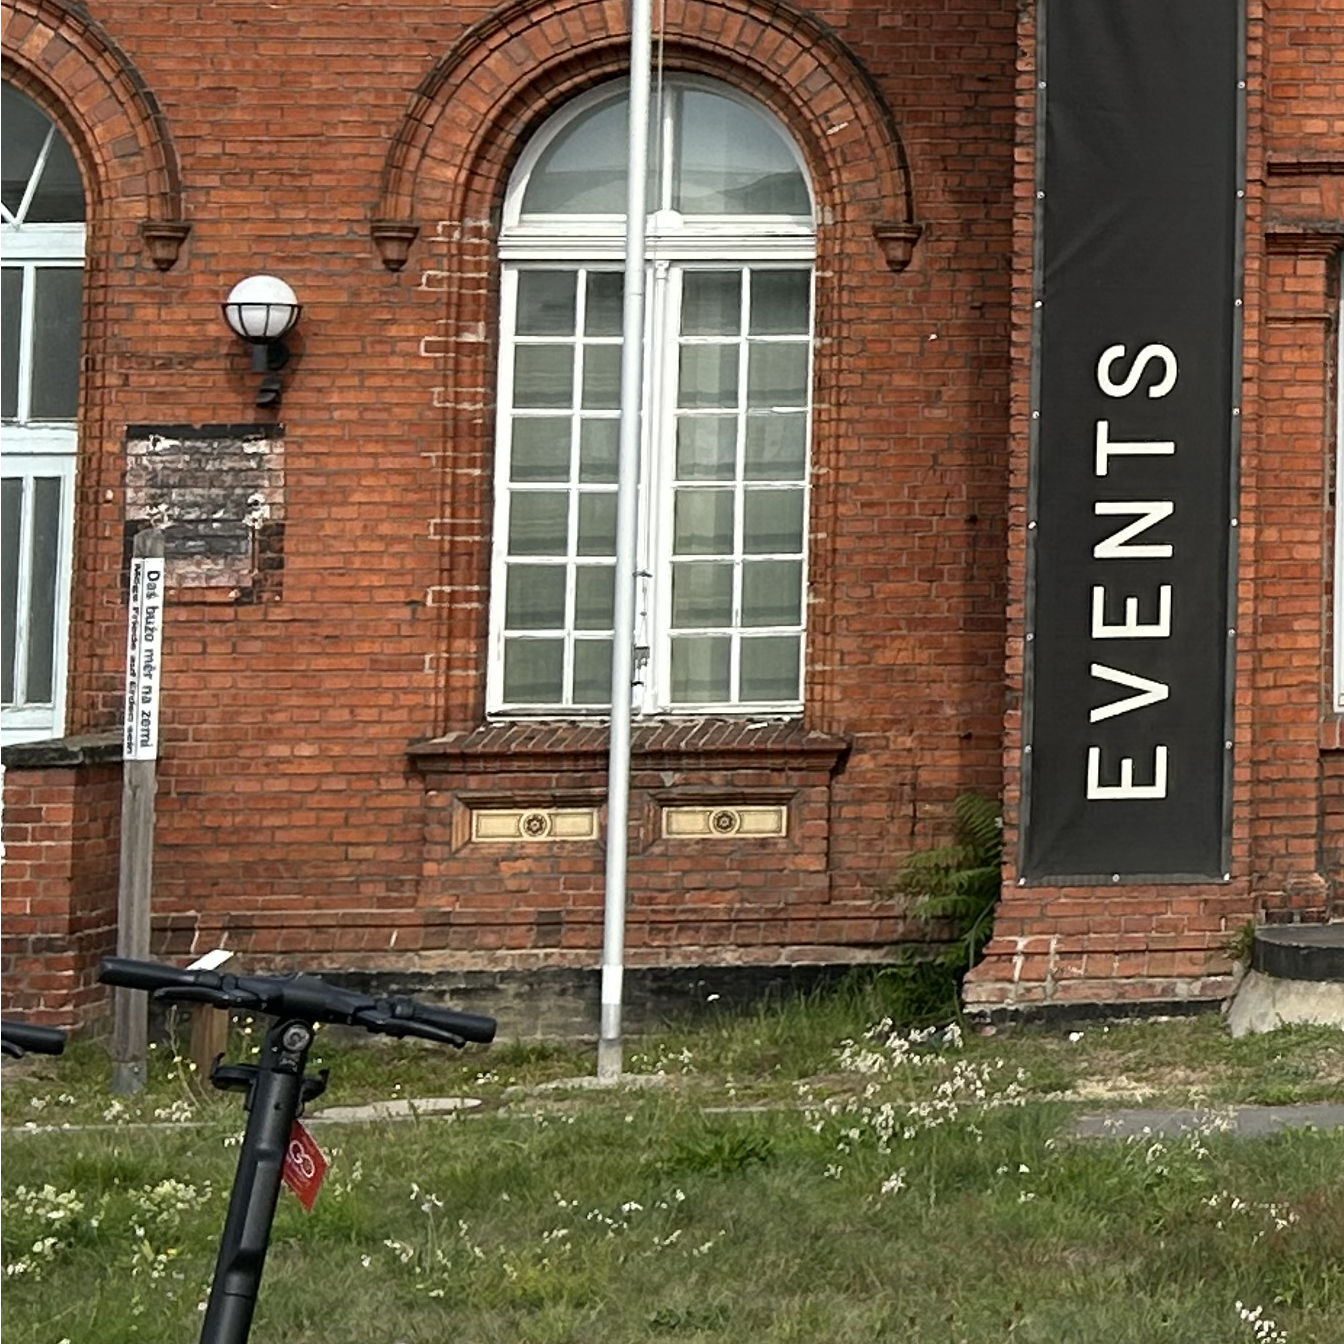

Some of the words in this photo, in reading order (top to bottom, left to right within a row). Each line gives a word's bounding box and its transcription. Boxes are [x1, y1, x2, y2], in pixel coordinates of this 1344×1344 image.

[1087, 342, 1178, 800] EVENTS
[141, 685, 152, 704] na
[140, 709, 153, 748] zemi
